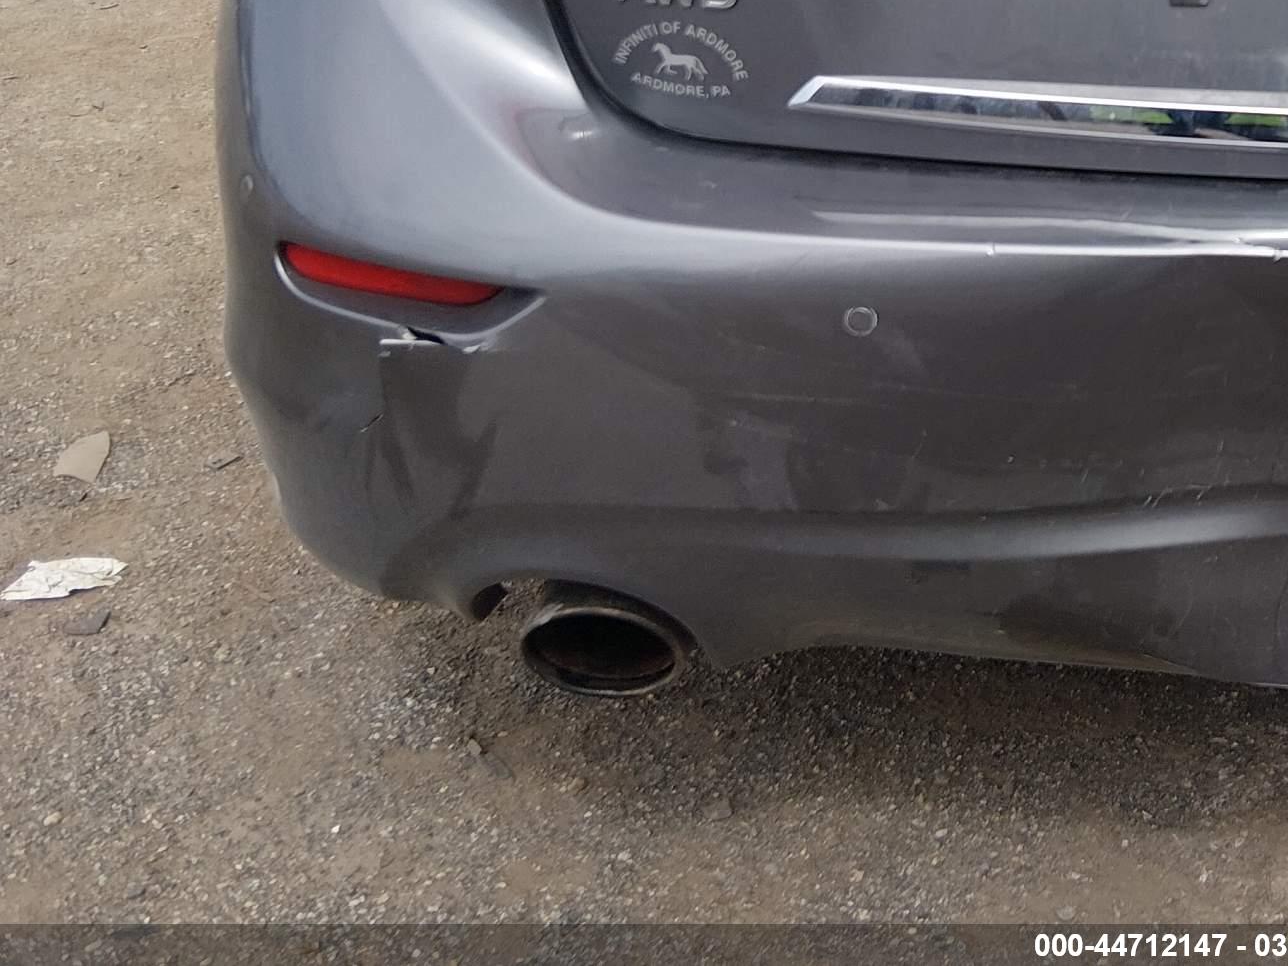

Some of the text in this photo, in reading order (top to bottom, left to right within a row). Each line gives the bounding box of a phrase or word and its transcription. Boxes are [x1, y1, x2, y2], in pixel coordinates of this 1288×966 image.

[613, 21, 748, 80] INFINITI OF ARDMORE
[631, 71, 731, 99] ARDMORE, PA
